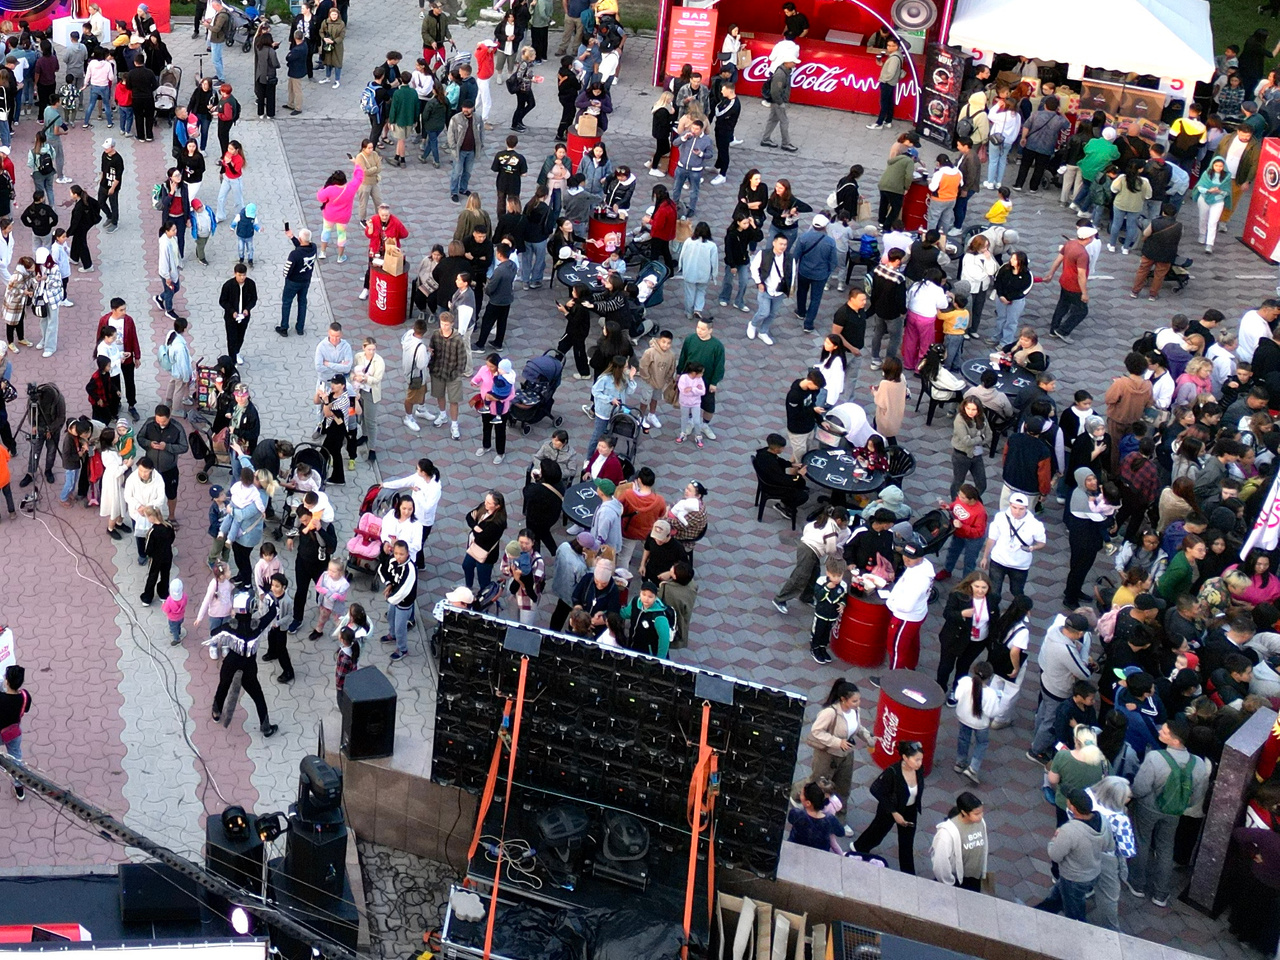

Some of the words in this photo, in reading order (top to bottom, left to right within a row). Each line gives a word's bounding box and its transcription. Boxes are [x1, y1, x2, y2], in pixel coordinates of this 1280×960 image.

[682, 12, 708, 20] BAR
[971, 47, 983, 60] 5
[375, 276, 387, 311] Coca-Cola
[881, 705, 899, 756] Coca-Cola
[967, 831, 983, 841] BON
[963, 838, 985, 850] VOYAG
